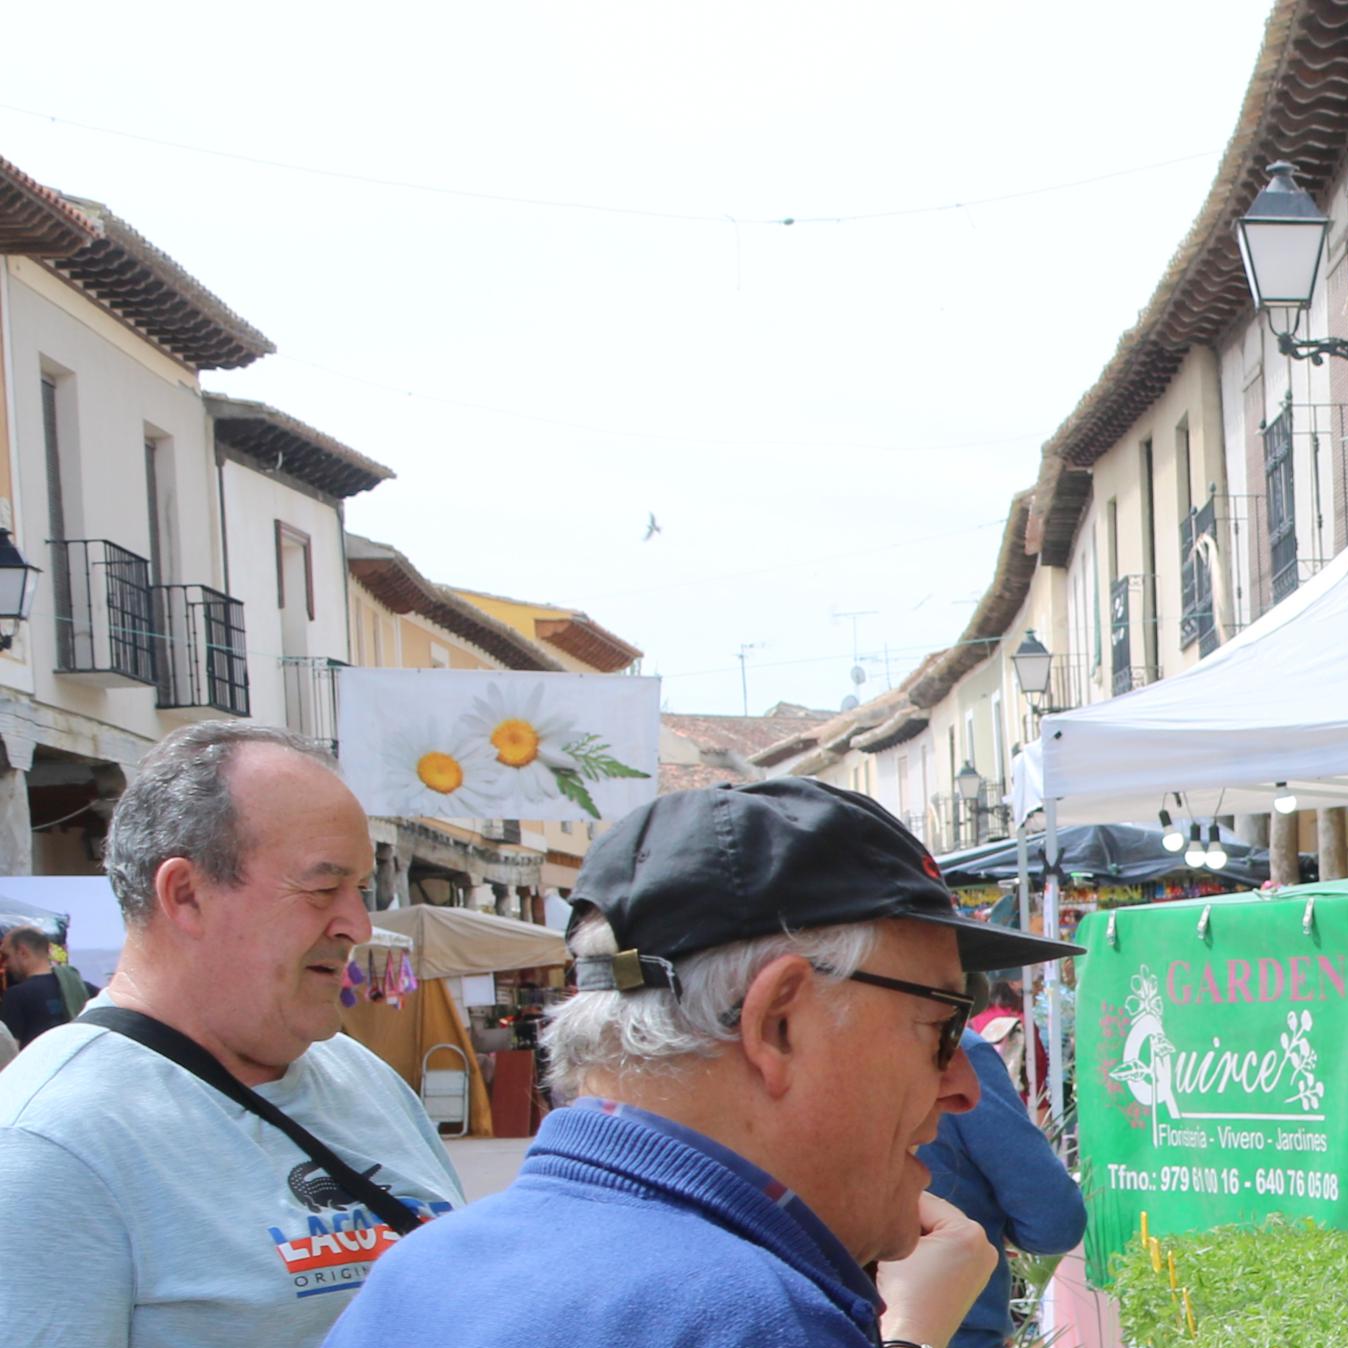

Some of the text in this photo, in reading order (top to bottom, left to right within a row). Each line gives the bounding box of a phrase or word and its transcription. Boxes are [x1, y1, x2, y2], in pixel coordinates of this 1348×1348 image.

[1166, 955, 1346, 1005] GARDEN
[1123, 1012, 1283, 1118] Quirce
[1218, 1126, 1264, 1150] Vivero
[1275, 1127, 1327, 1152] Jardines
[1107, 1163, 1156, 1191] Tfno.:
[1160, 1166, 1190, 1191] 979
[1221, 1168, 1239, 1194] 16
[1255, 1168, 1284, 1195] 640
[1287, 1170, 1304, 1197] 76
